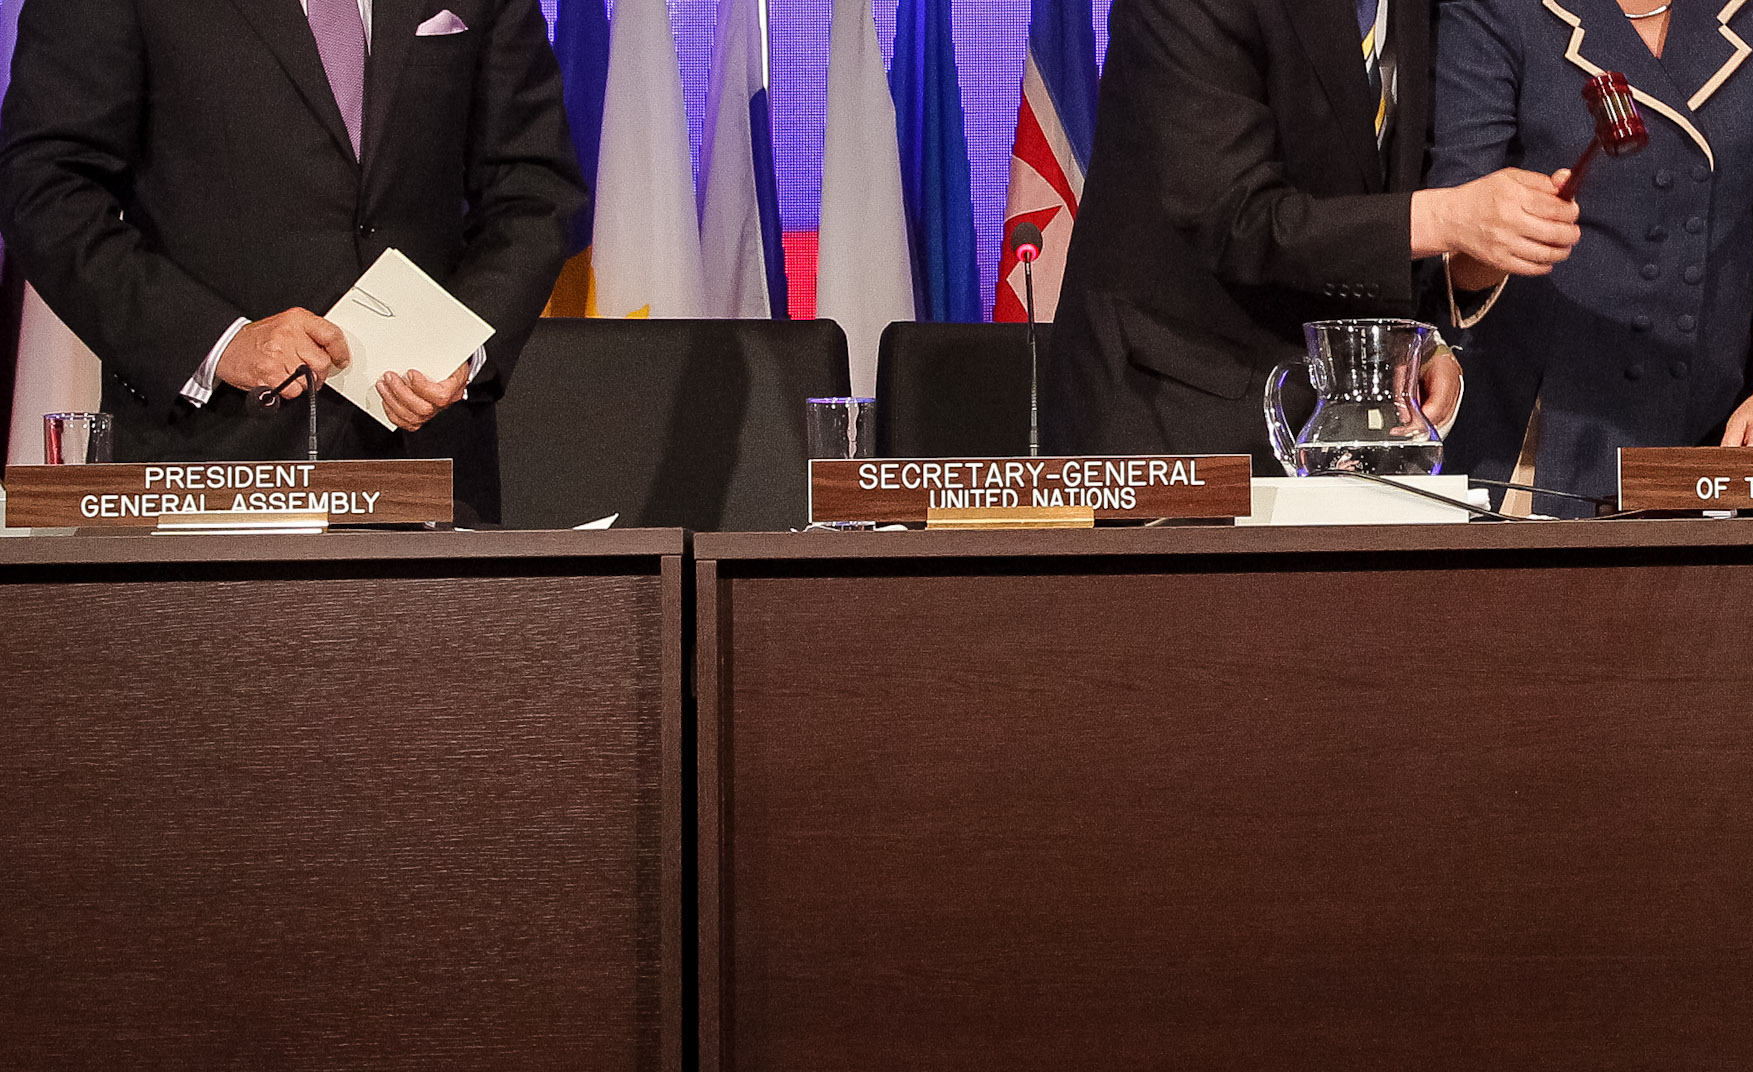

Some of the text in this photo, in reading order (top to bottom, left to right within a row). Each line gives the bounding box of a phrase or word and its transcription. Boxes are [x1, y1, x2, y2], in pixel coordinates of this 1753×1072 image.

[145, 465, 315, 489] PRESIDENT
[858, 460, 1206, 489] SECRETARY-GENERAL
[929, 487, 1137, 510] UNITED NATIONS
[1696, 477, 1730, 499] OF
[81, 491, 381, 517] GENERAL ASSEMBLY
